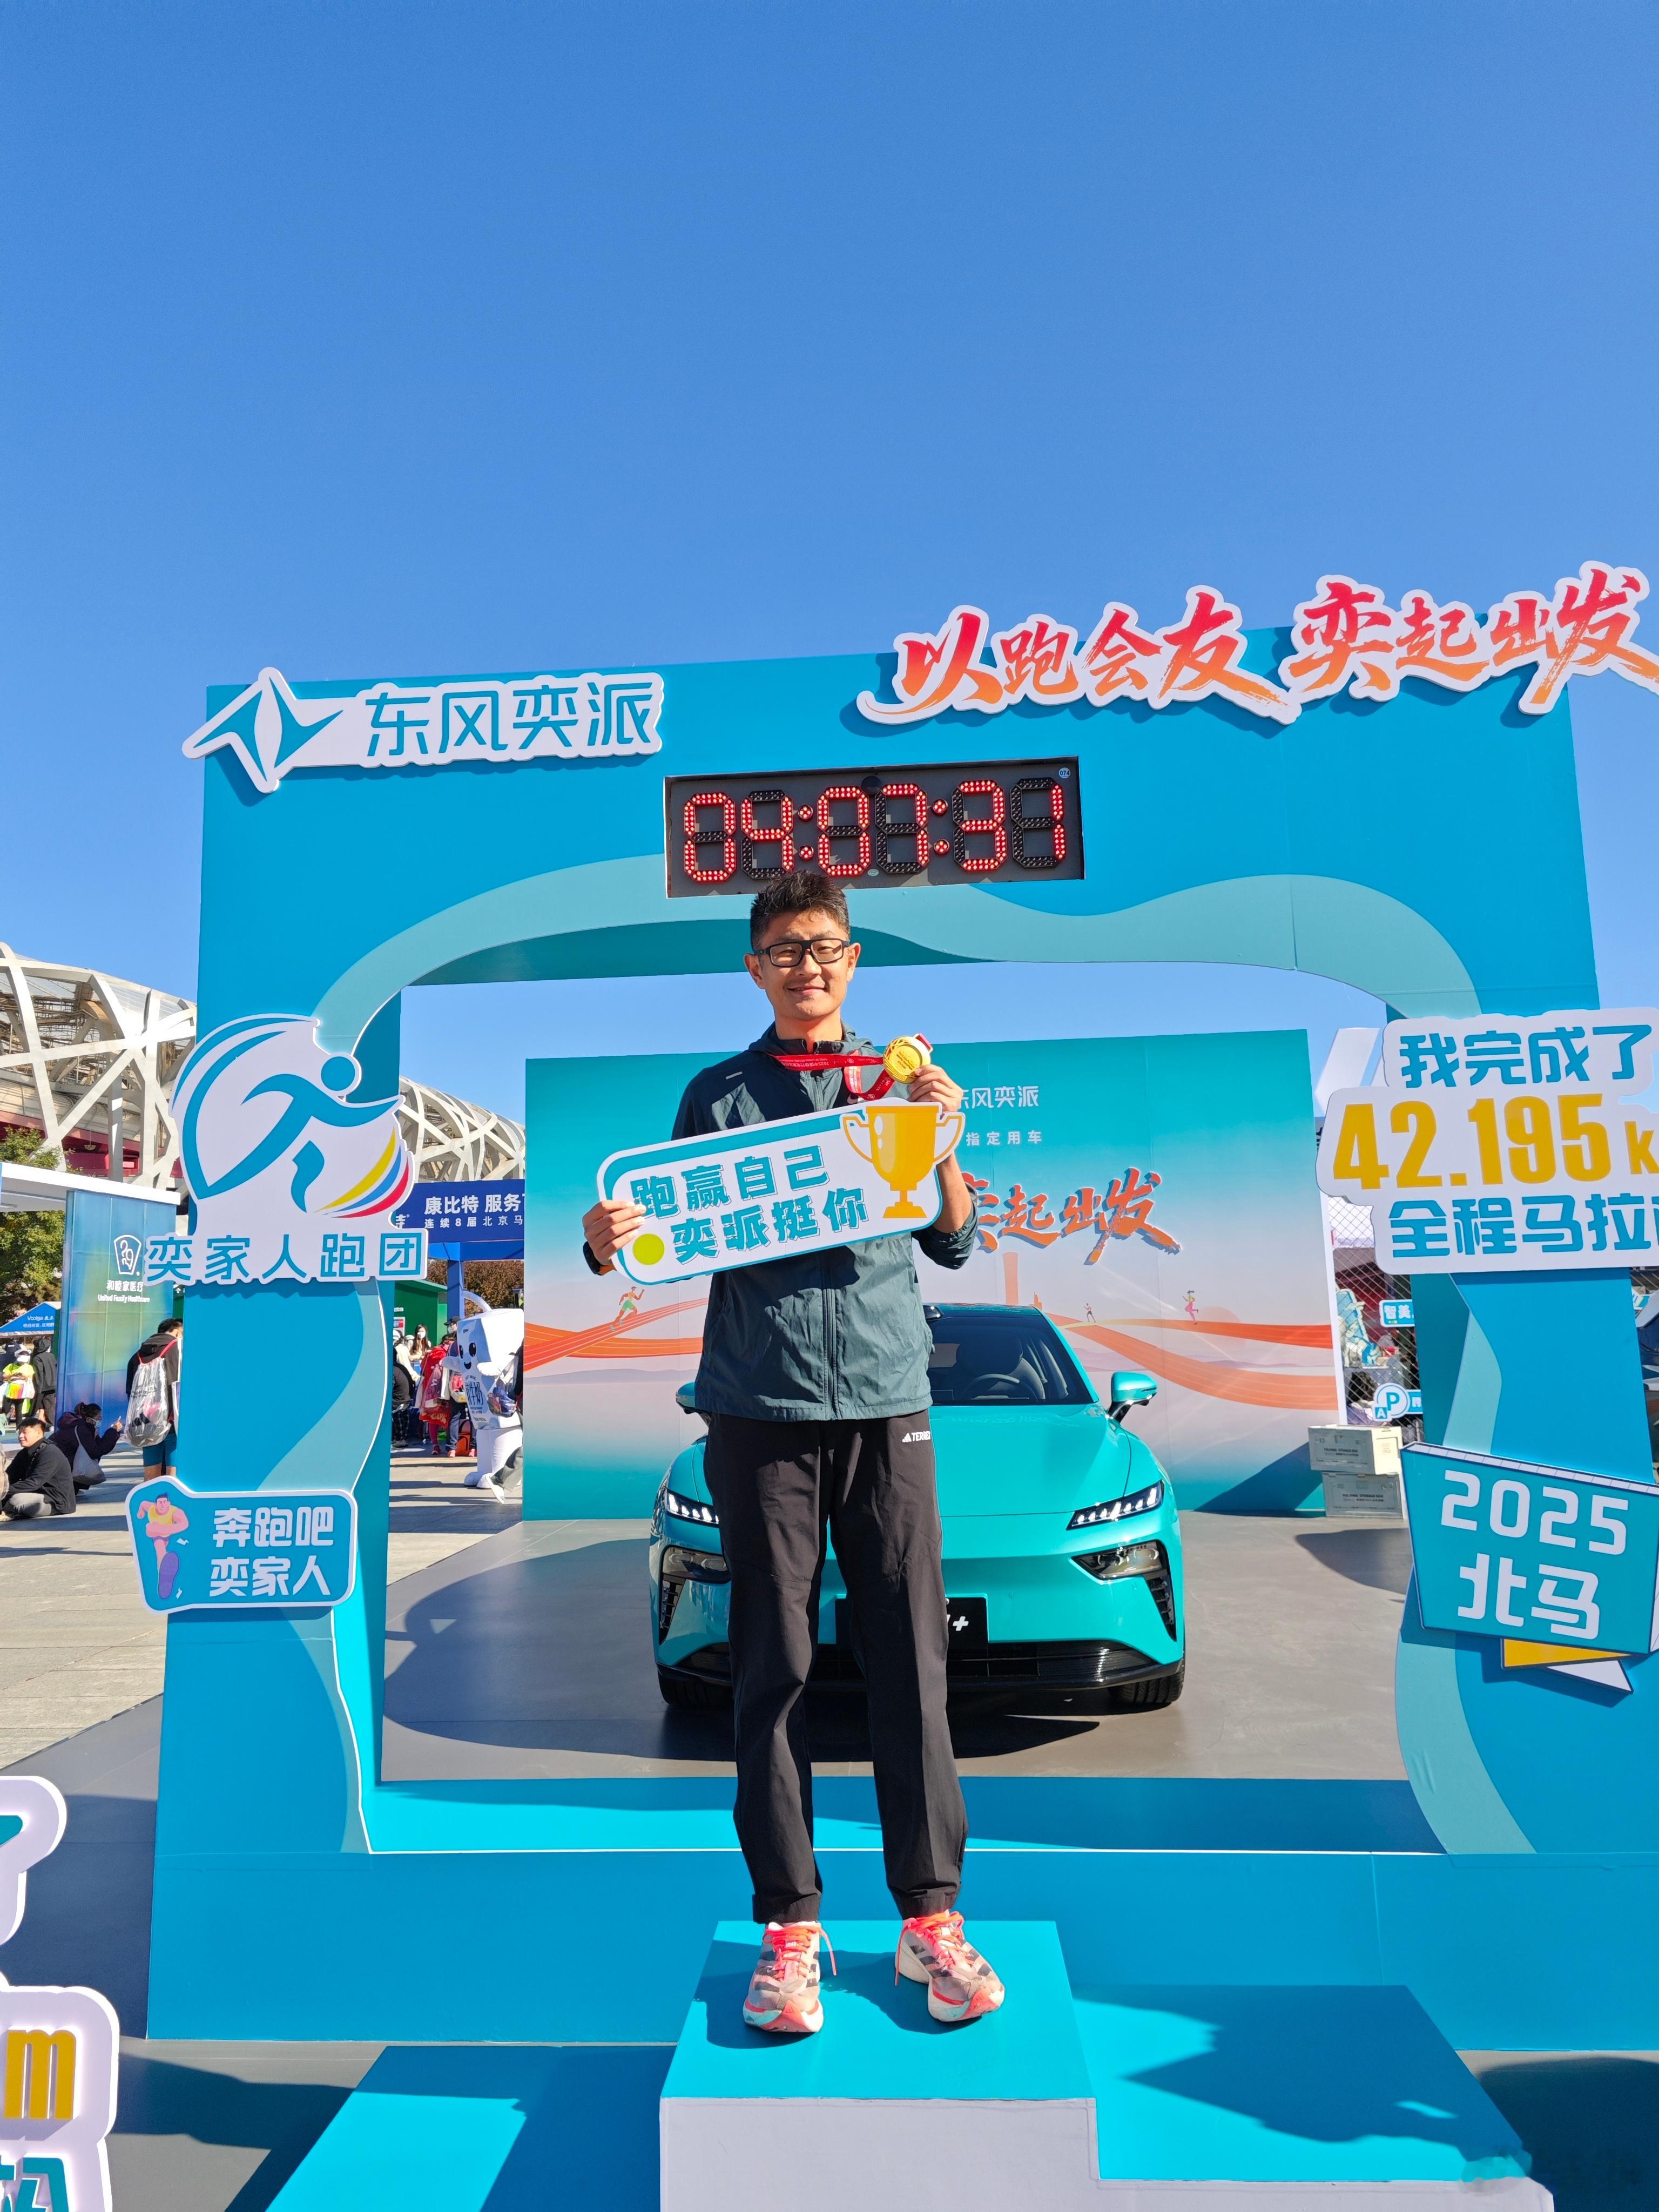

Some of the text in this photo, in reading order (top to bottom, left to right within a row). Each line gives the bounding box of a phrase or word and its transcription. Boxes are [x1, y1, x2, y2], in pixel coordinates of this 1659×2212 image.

[862, 567, 1659, 717] 以跑会友 奕起出发
[365, 682, 653, 756] 东风奕派
[1399, 1024, 1652, 1088] 我完成了
[966, 1130, 1042, 1146] 指定用车
[1333, 1093, 1611, 1190] 42.195
[424, 1193, 525, 1215] 康比特 服务
[630, 1145, 830, 1220] 跑赢自己
[671, 1188, 868, 1264] 奕派挺你
[1388, 1193, 1659, 1258] 全程马拉
[147, 1233, 422, 1282] 奕家人跑团
[106, 1280, 144, 1292] 和睦家医疗
[113, 1294, 127, 1303] Family
[1384, 1305, 1414, 1319] 智美
[1377, 1408, 1386, 1418] A
[1386, 1392, 1400, 1411] P
[213, 1506, 334, 1547] 奔跑吧
[1440, 1470, 1629, 1555] 2025
[210, 1555, 331, 1597] 奕家人
[1458, 1553, 1600, 1640] 北马
[4, 2030, 77, 2120] m
